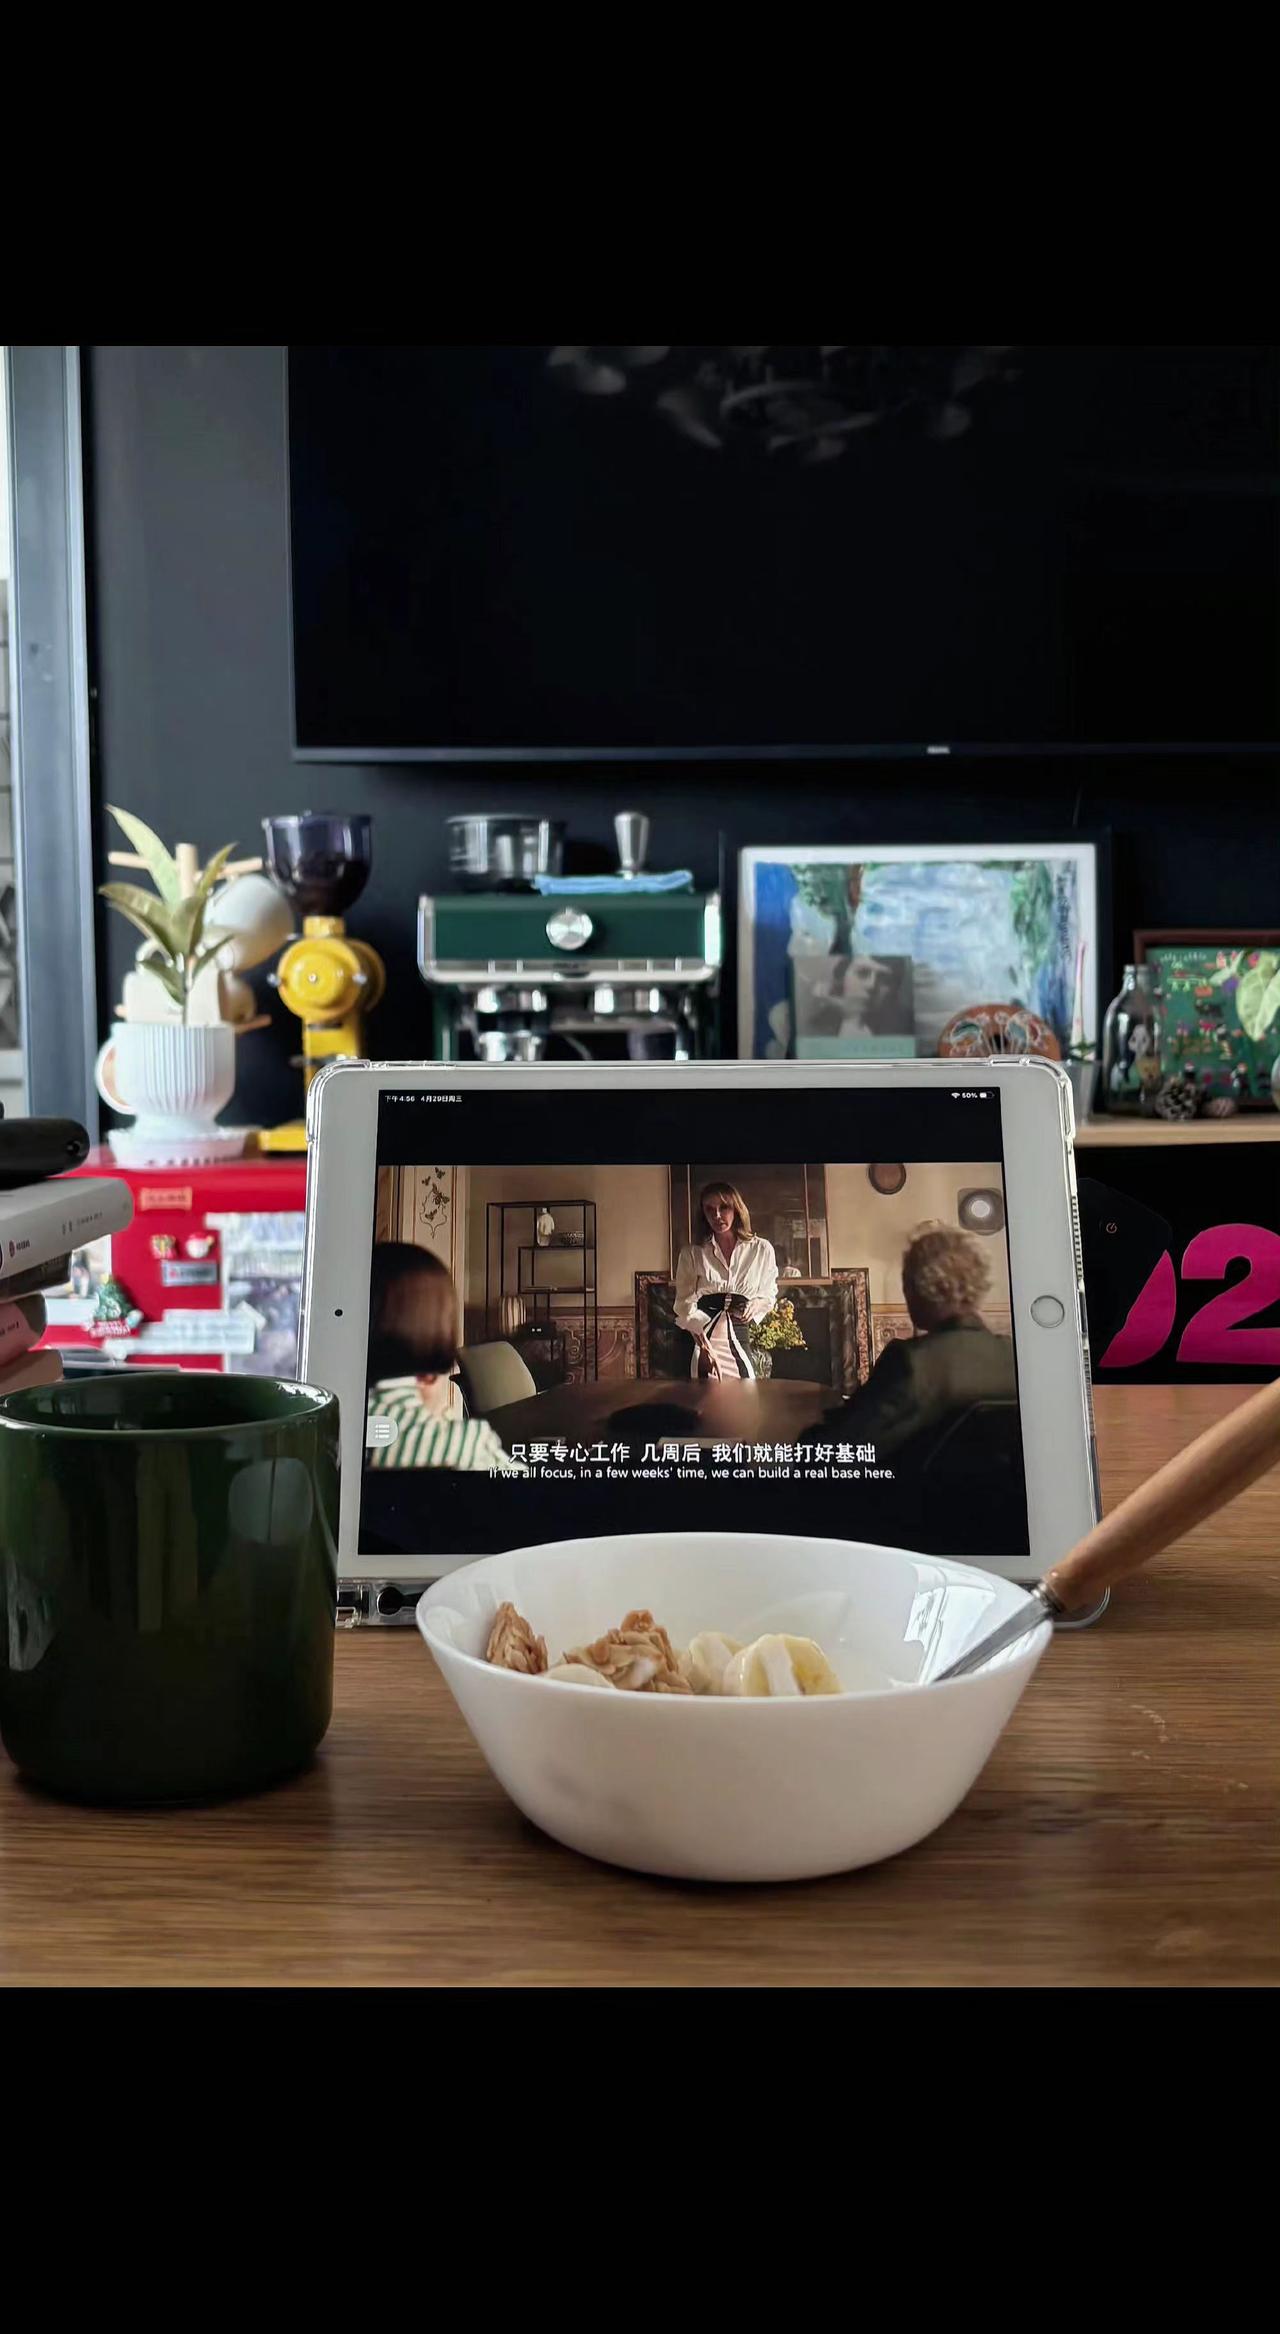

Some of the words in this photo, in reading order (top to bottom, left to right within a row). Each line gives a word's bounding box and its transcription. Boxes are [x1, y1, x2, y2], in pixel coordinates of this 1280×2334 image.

[509, 1440, 630, 1463] 只要专心工作
[640, 1442, 701, 1463] 几周后
[711, 1442, 877, 1463] 我们就能打好基础
[488, 1466, 498, 1479] If
[501, 1469, 519, 1479] we
[522, 1466, 537, 1479] all
[540, 1466, 576, 1480] focus,
[580, 1466, 592, 1479] in
[595, 1469, 603, 1479] a
[606, 1466, 629, 1479] few
[631, 1466, 673, 1479] weeks'
[676, 1466, 708, 1480] time,
[711, 1469, 730, 1479] we
[732, 1469, 755, 1479] can
[758, 1466, 790, 1479] build
[793, 1469, 801, 1479] a
[804, 1466, 828, 1479] real
[831, 1466, 861, 1479] base
[864, 1466, 896, 1479] here.
